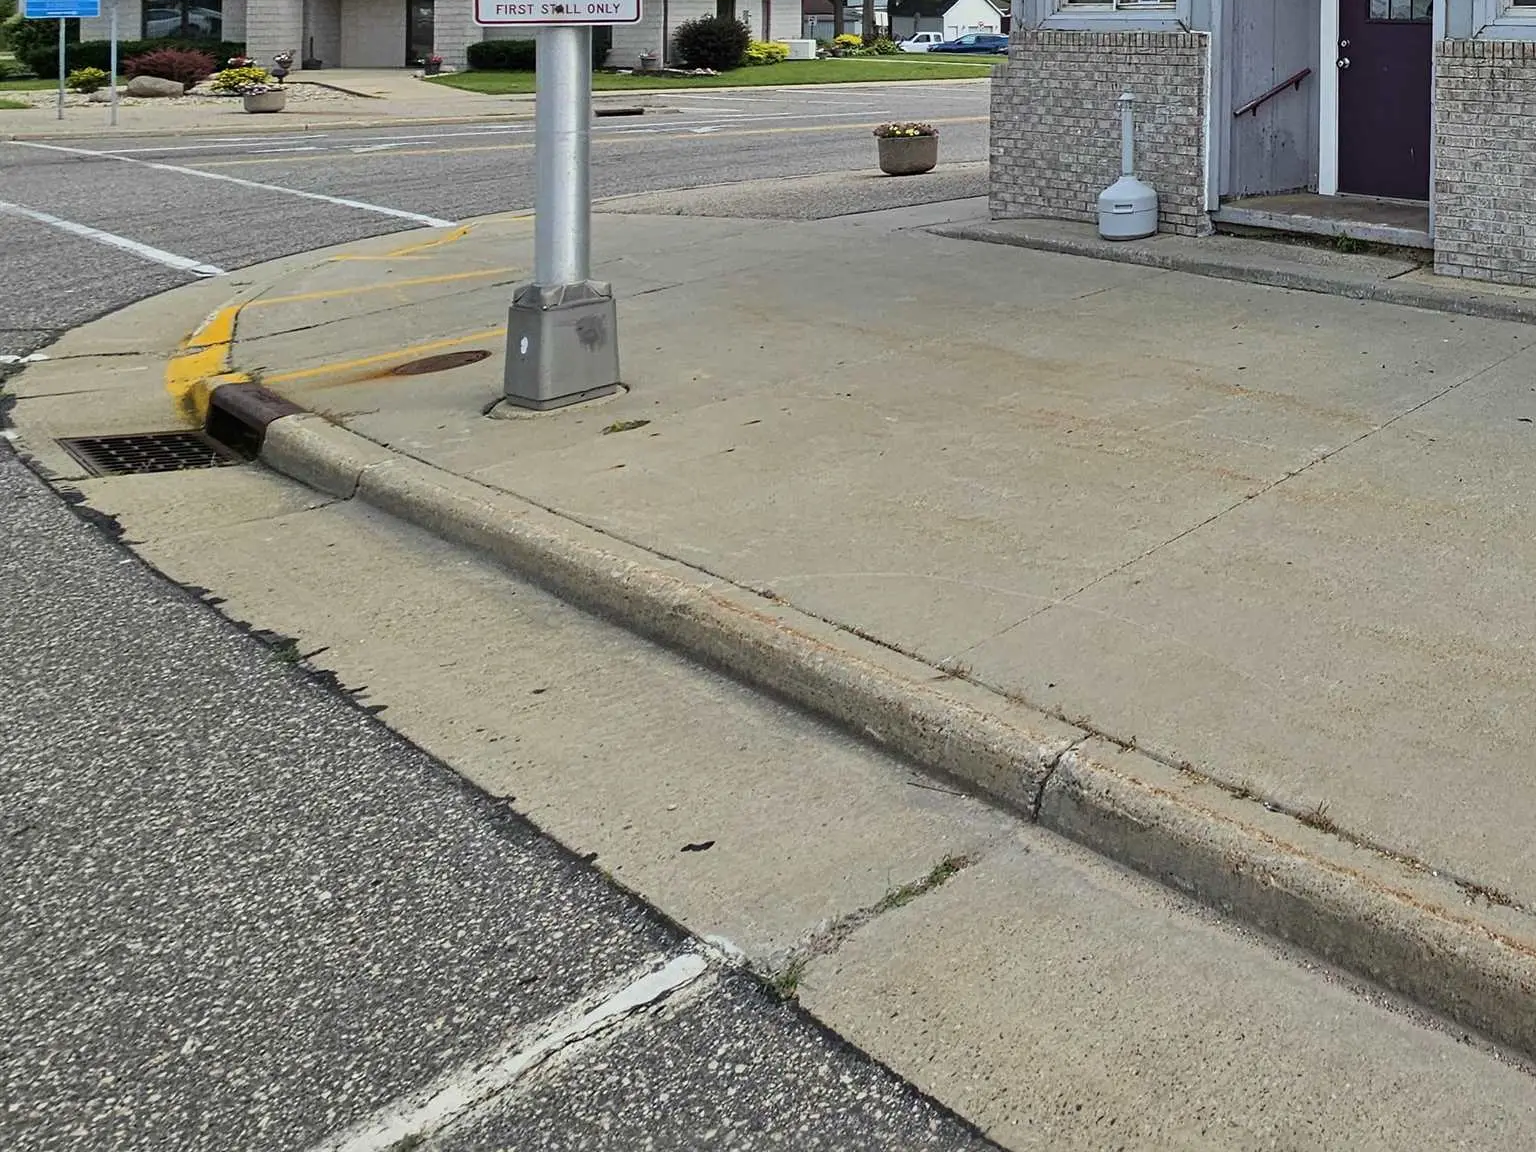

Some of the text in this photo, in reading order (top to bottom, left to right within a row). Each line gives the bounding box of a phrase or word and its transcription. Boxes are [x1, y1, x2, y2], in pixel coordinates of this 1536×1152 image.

[496, 3, 621, 15] FIRST STLL ONLY
